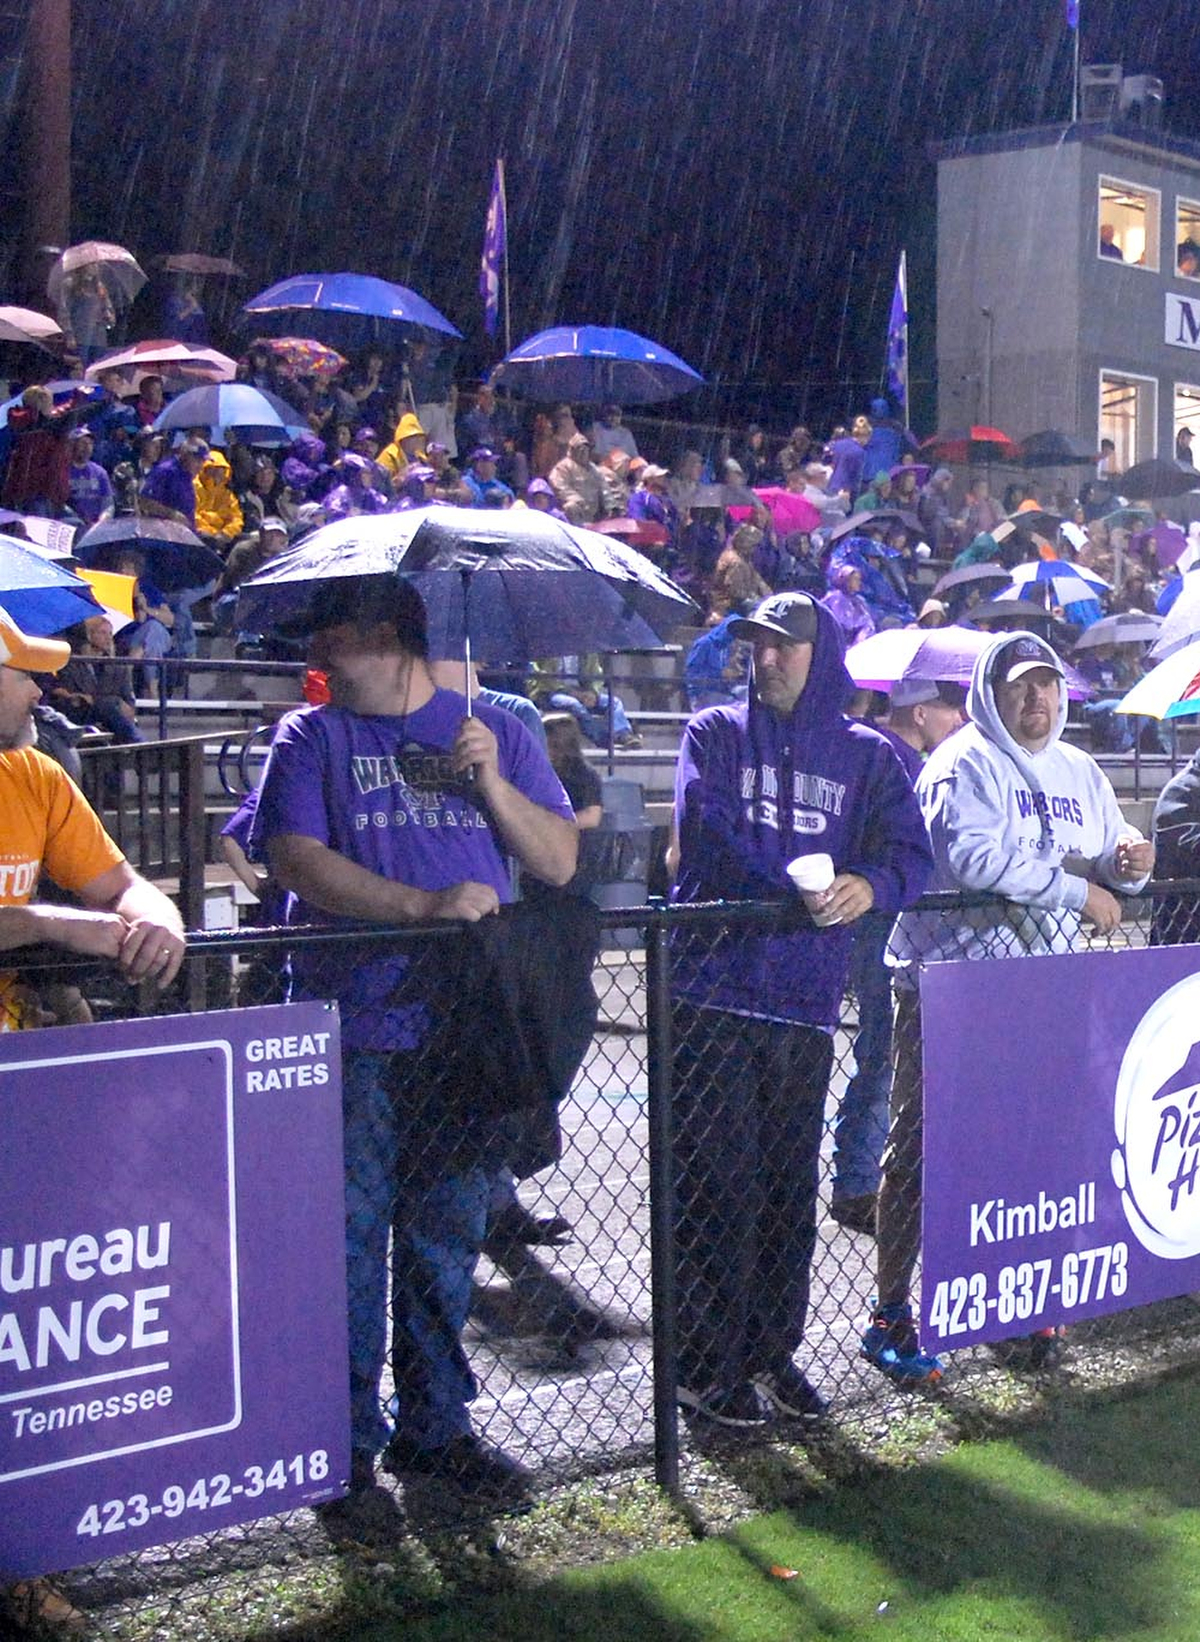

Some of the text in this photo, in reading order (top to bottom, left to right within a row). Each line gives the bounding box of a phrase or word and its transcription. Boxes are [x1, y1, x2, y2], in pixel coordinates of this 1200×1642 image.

[246, 1033, 330, 1063] GREAT
[246, 1063, 329, 1093] RATES
[970, 1182, 1096, 1247] Kimball
[929, 1242, 1129, 1338] 423-837-6773
[12, 1384, 173, 1438] Tennessee
[76, 1449, 329, 1537] 423-942-3418
